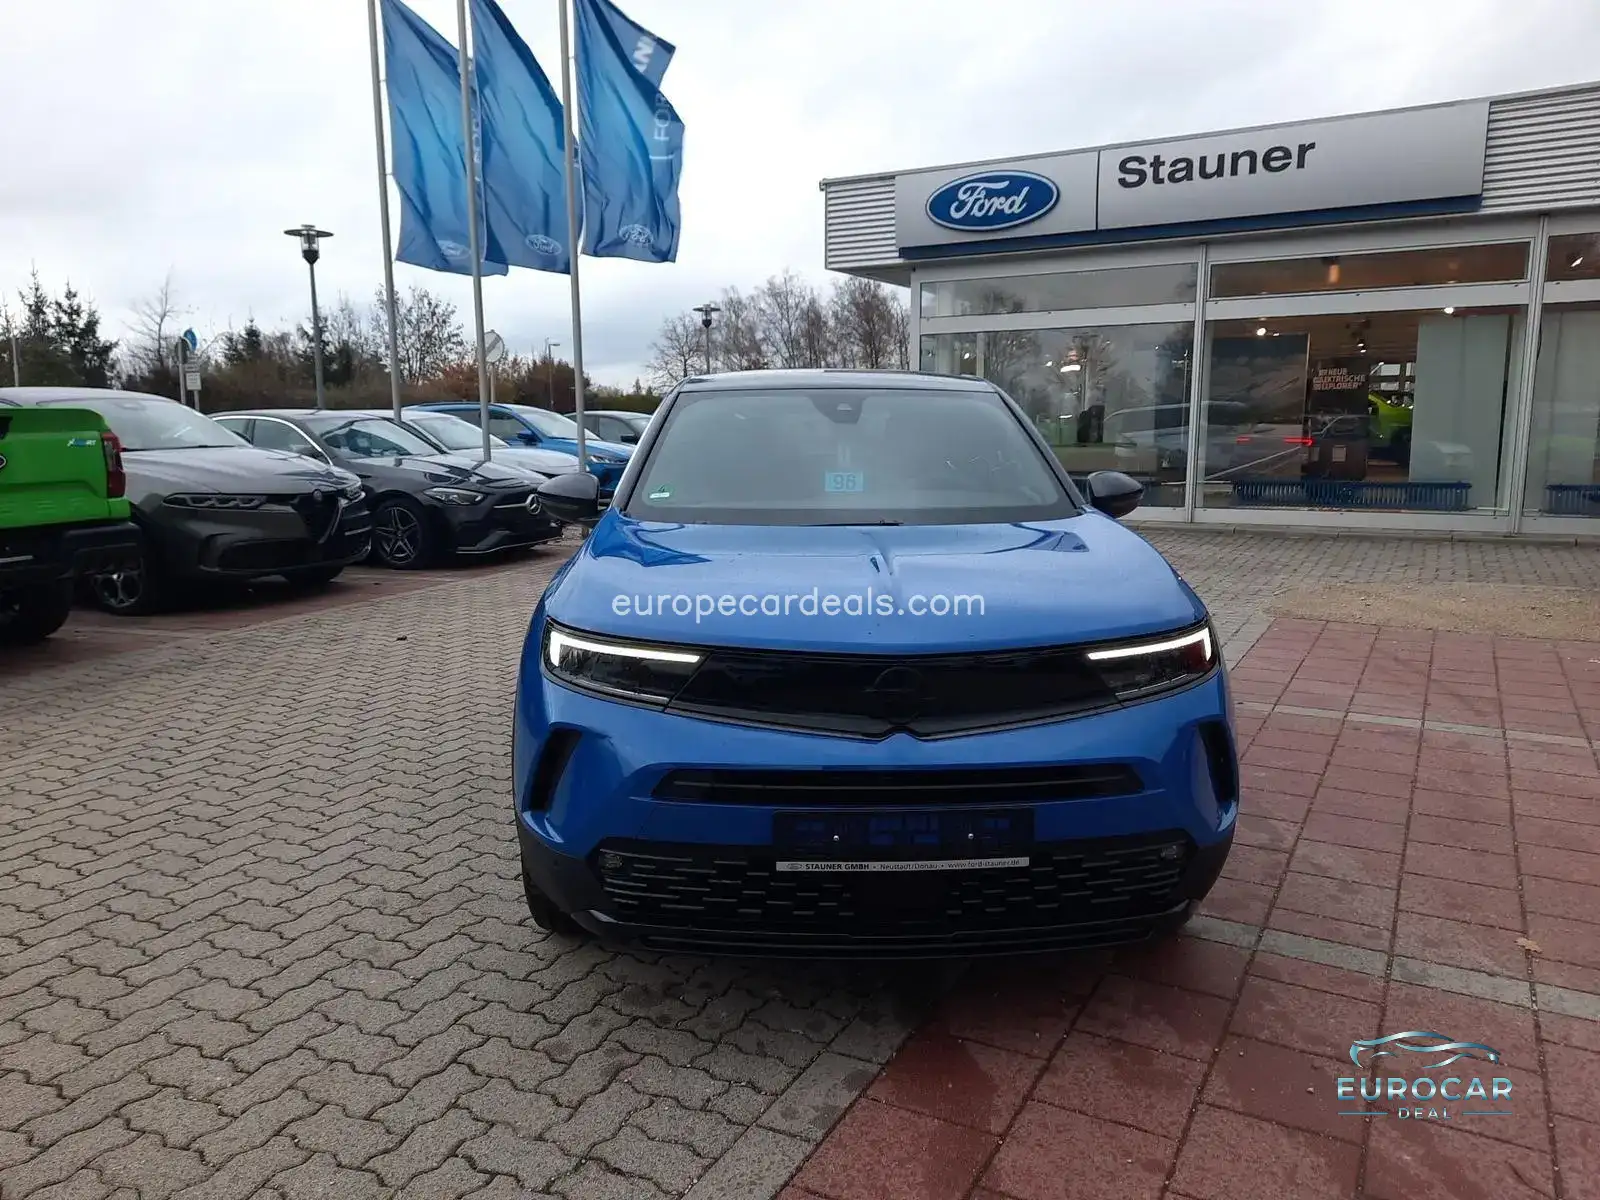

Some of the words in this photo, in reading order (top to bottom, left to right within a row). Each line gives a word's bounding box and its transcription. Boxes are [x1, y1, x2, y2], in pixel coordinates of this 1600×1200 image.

[1118, 142, 1316, 189] Stauner
[950, 180, 1031, 220] Ford
[833, 474, 856, 490] 96
